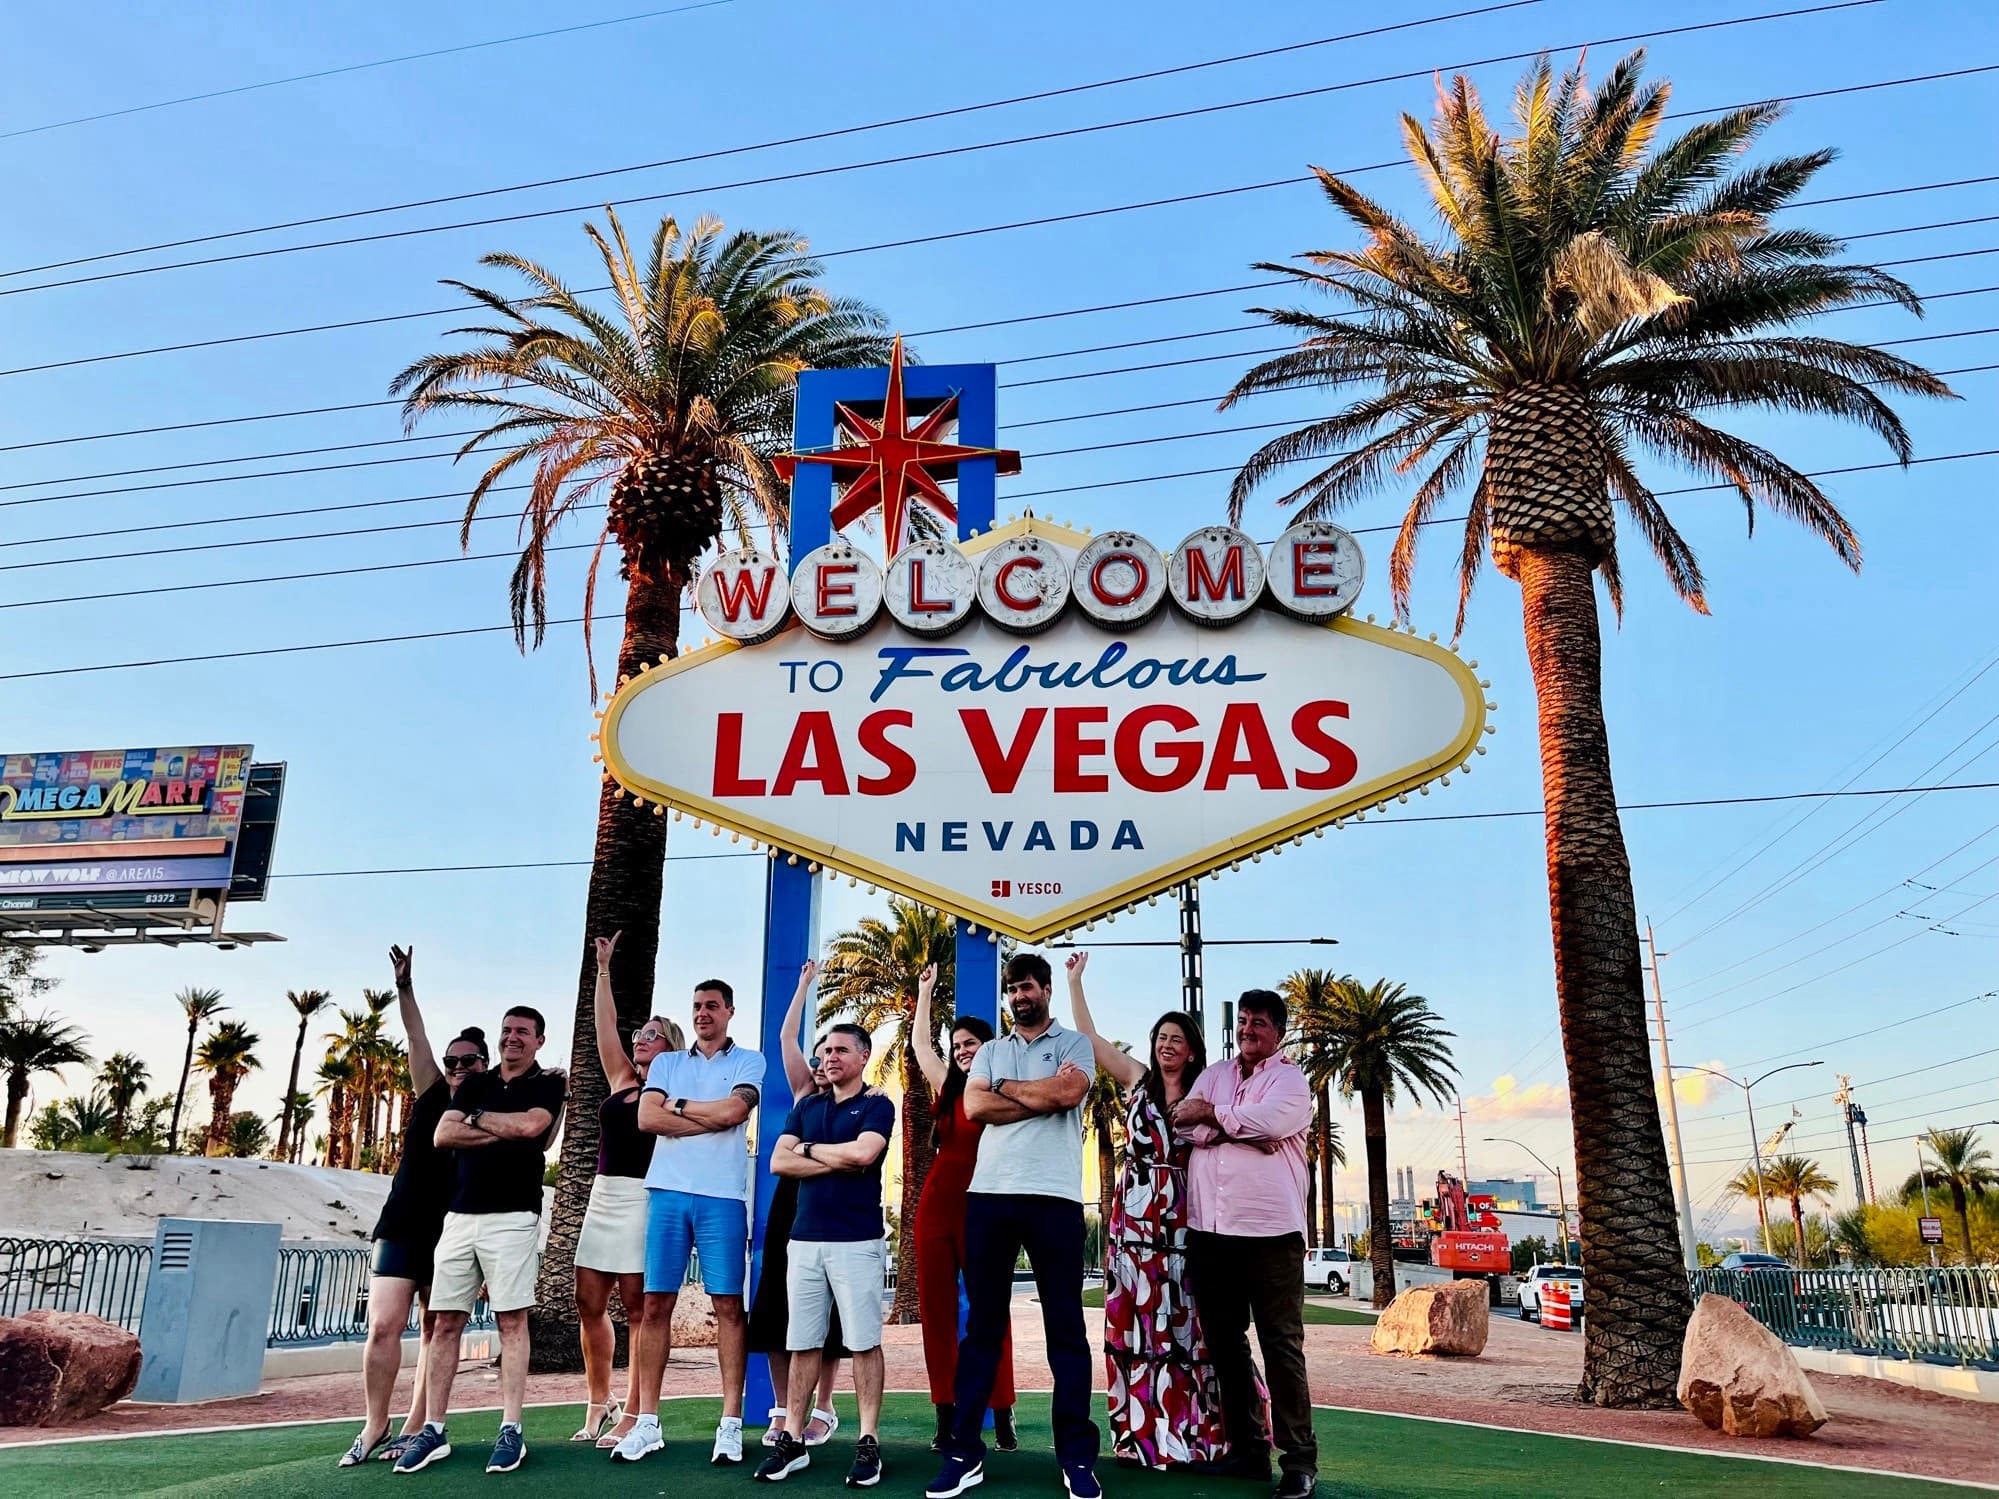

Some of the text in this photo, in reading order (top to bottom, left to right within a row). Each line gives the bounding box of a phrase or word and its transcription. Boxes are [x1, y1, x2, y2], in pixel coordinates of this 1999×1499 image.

[713, 540, 1339, 623] WELCOME
[779, 641, 1267, 704] TO Fabulous
[92, 759, 123, 769] KIWIS
[712, 700, 1358, 797] LAS VEGAS
[103, 779, 205, 816] MART
[895, 820, 1145, 852] NEVADA
[52, 868, 101, 882] WOLF
[1017, 882, 1062, 895] YESCO
[1455, 1242, 1494, 1252] HITACHI
